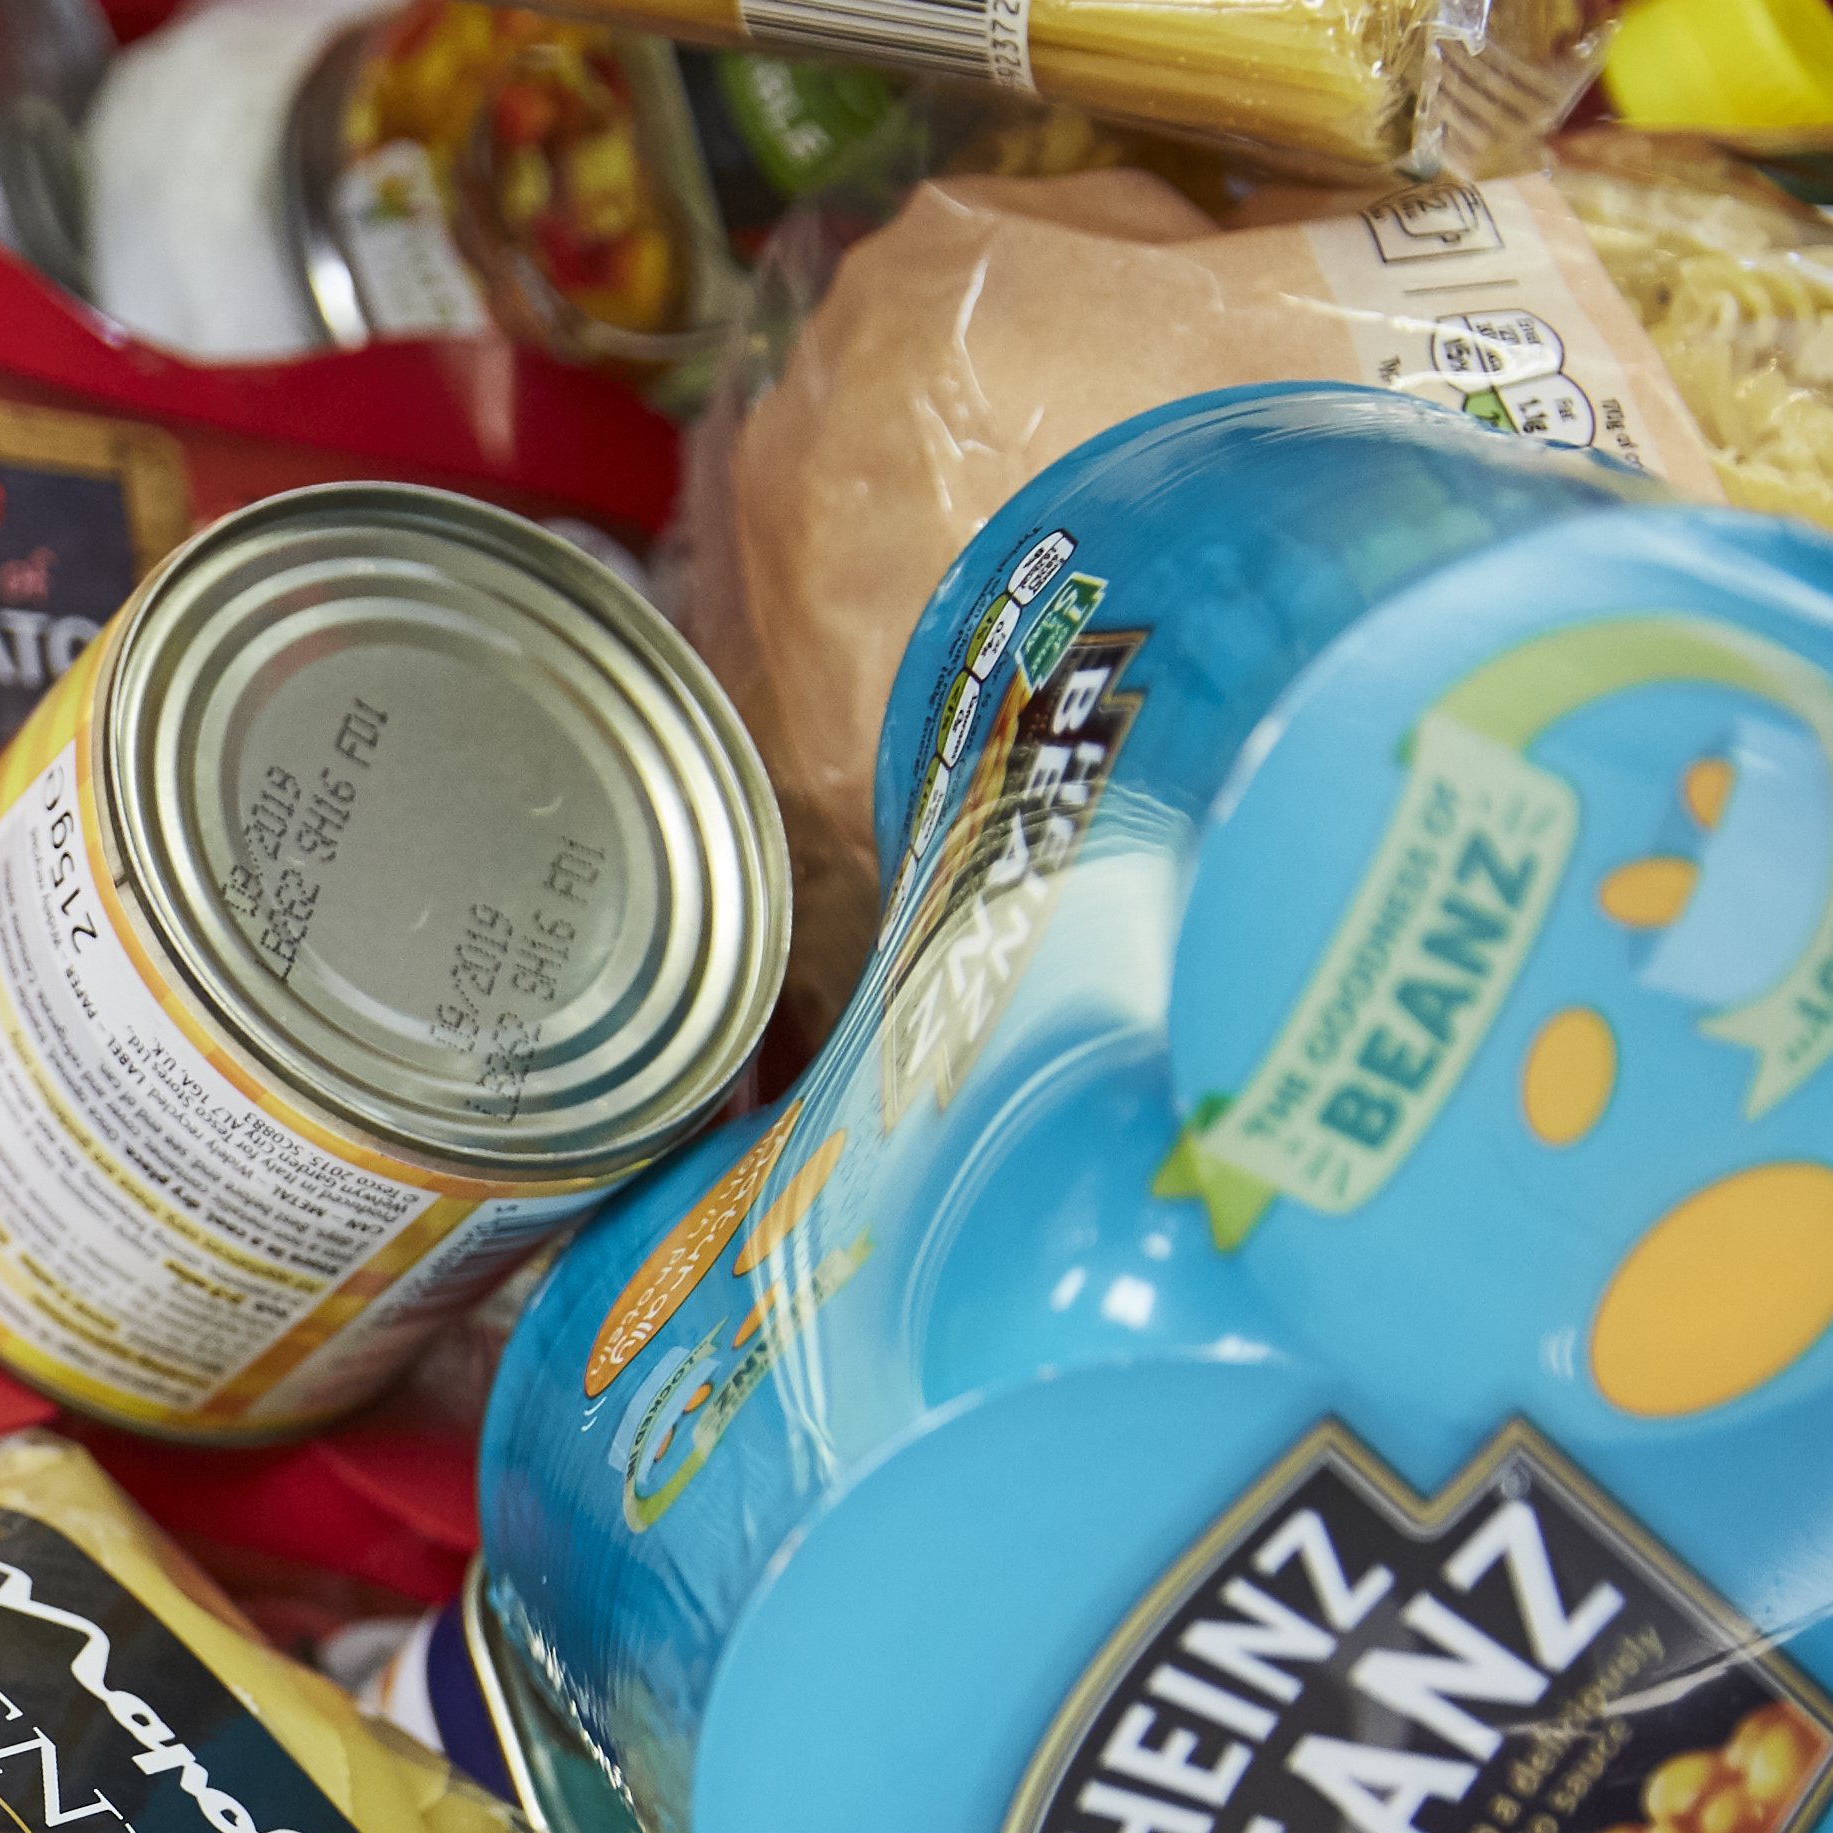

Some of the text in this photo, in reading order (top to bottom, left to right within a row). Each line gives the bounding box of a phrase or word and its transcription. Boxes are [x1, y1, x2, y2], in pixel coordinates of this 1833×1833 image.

[50, 809, 99, 954] 215g
[908, 666, 1112, 1078] BEANZ
[66, 965, 146, 1085] LABEL PAPER
[1318, 829, 1539, 1151] BEANZ
[147, 1082, 328, 1217] METAL Widely recycled.
[152, 1060, 298, 1185] Italy for Tesco Stores
[152, 1036, 409, 1215] Welwyn Garden City AL7 1GA, U.K.
[357, 1175, 401, 1199] Tesco
[590, 1247, 686, 1377] protein
[1491, 1792, 1523, 1827] a
[1548, 1720, 1634, 1816] sauce
